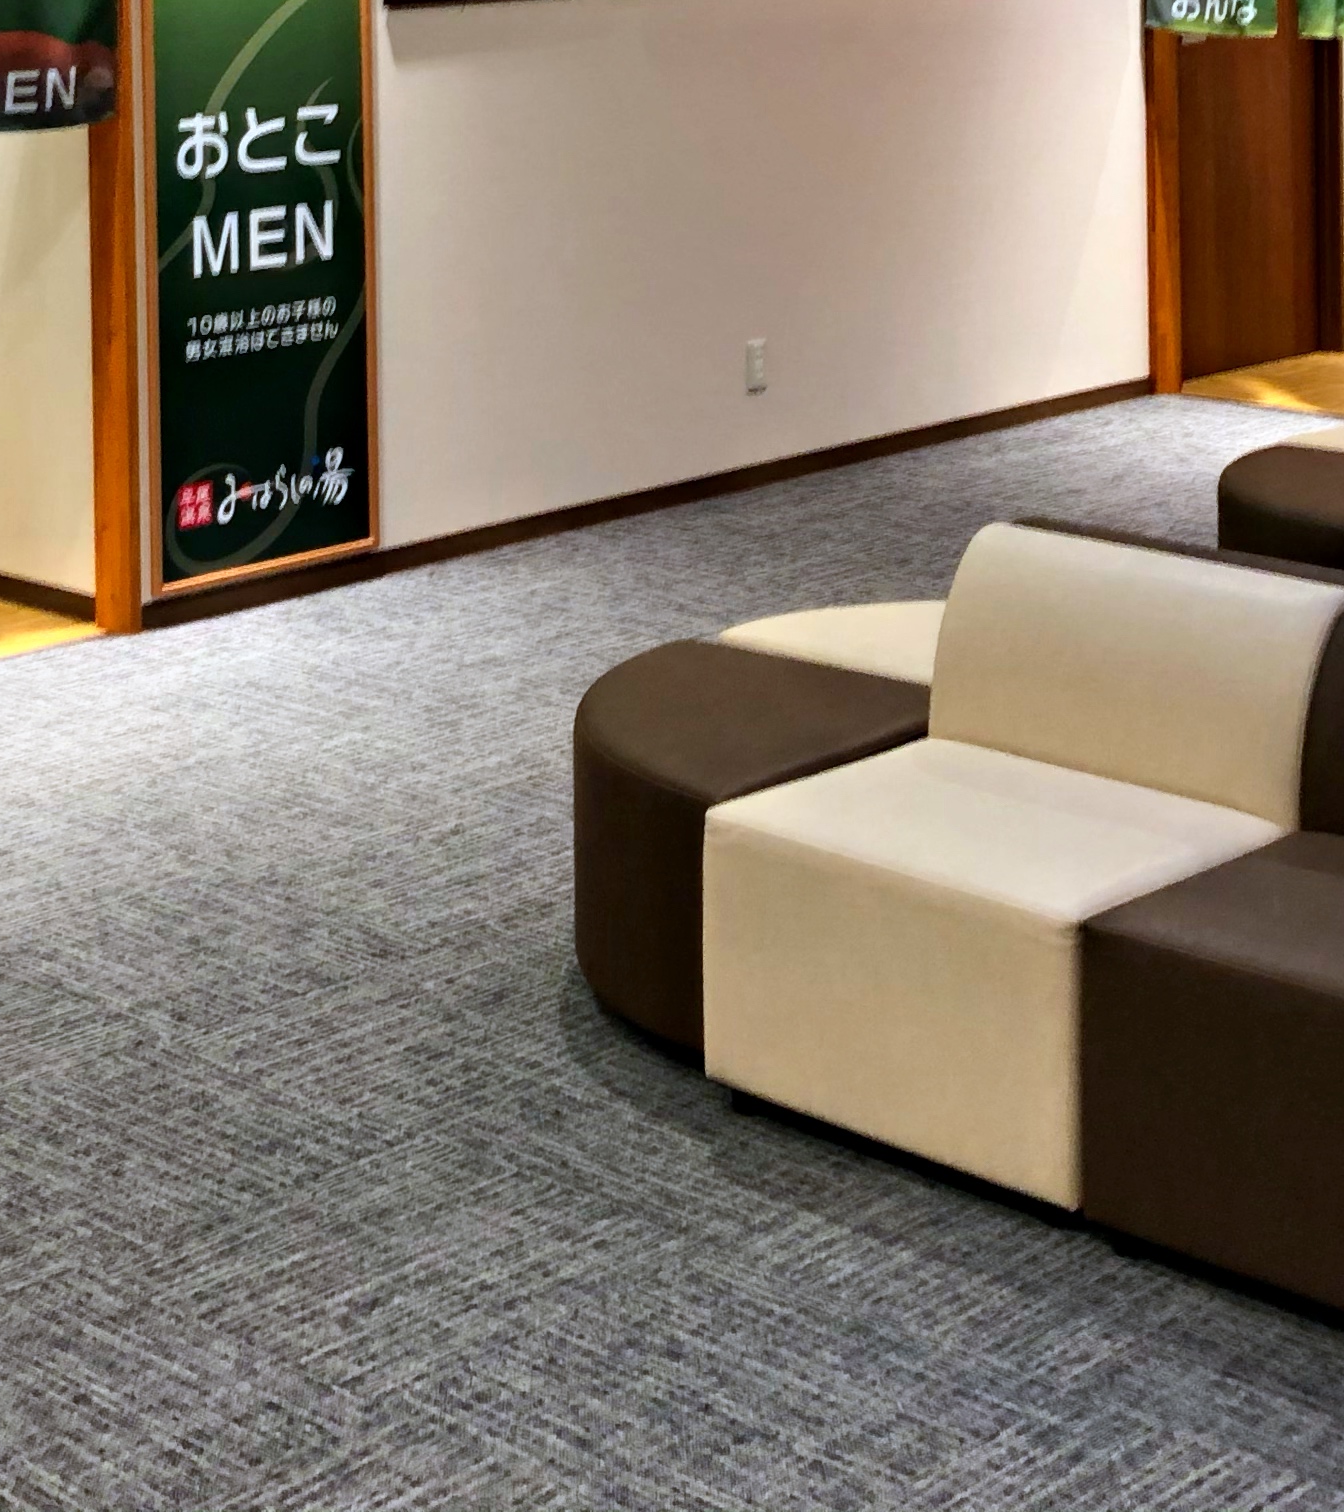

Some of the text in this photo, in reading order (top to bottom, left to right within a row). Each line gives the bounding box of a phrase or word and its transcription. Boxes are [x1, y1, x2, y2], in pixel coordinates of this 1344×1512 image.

[176, 103, 341, 179] おとこ
[192, 200, 334, 279] MEN
[185, 320, 339, 363] 男女混浴はできません
[187, 296, 337, 337] 10歳以上のお子様の
